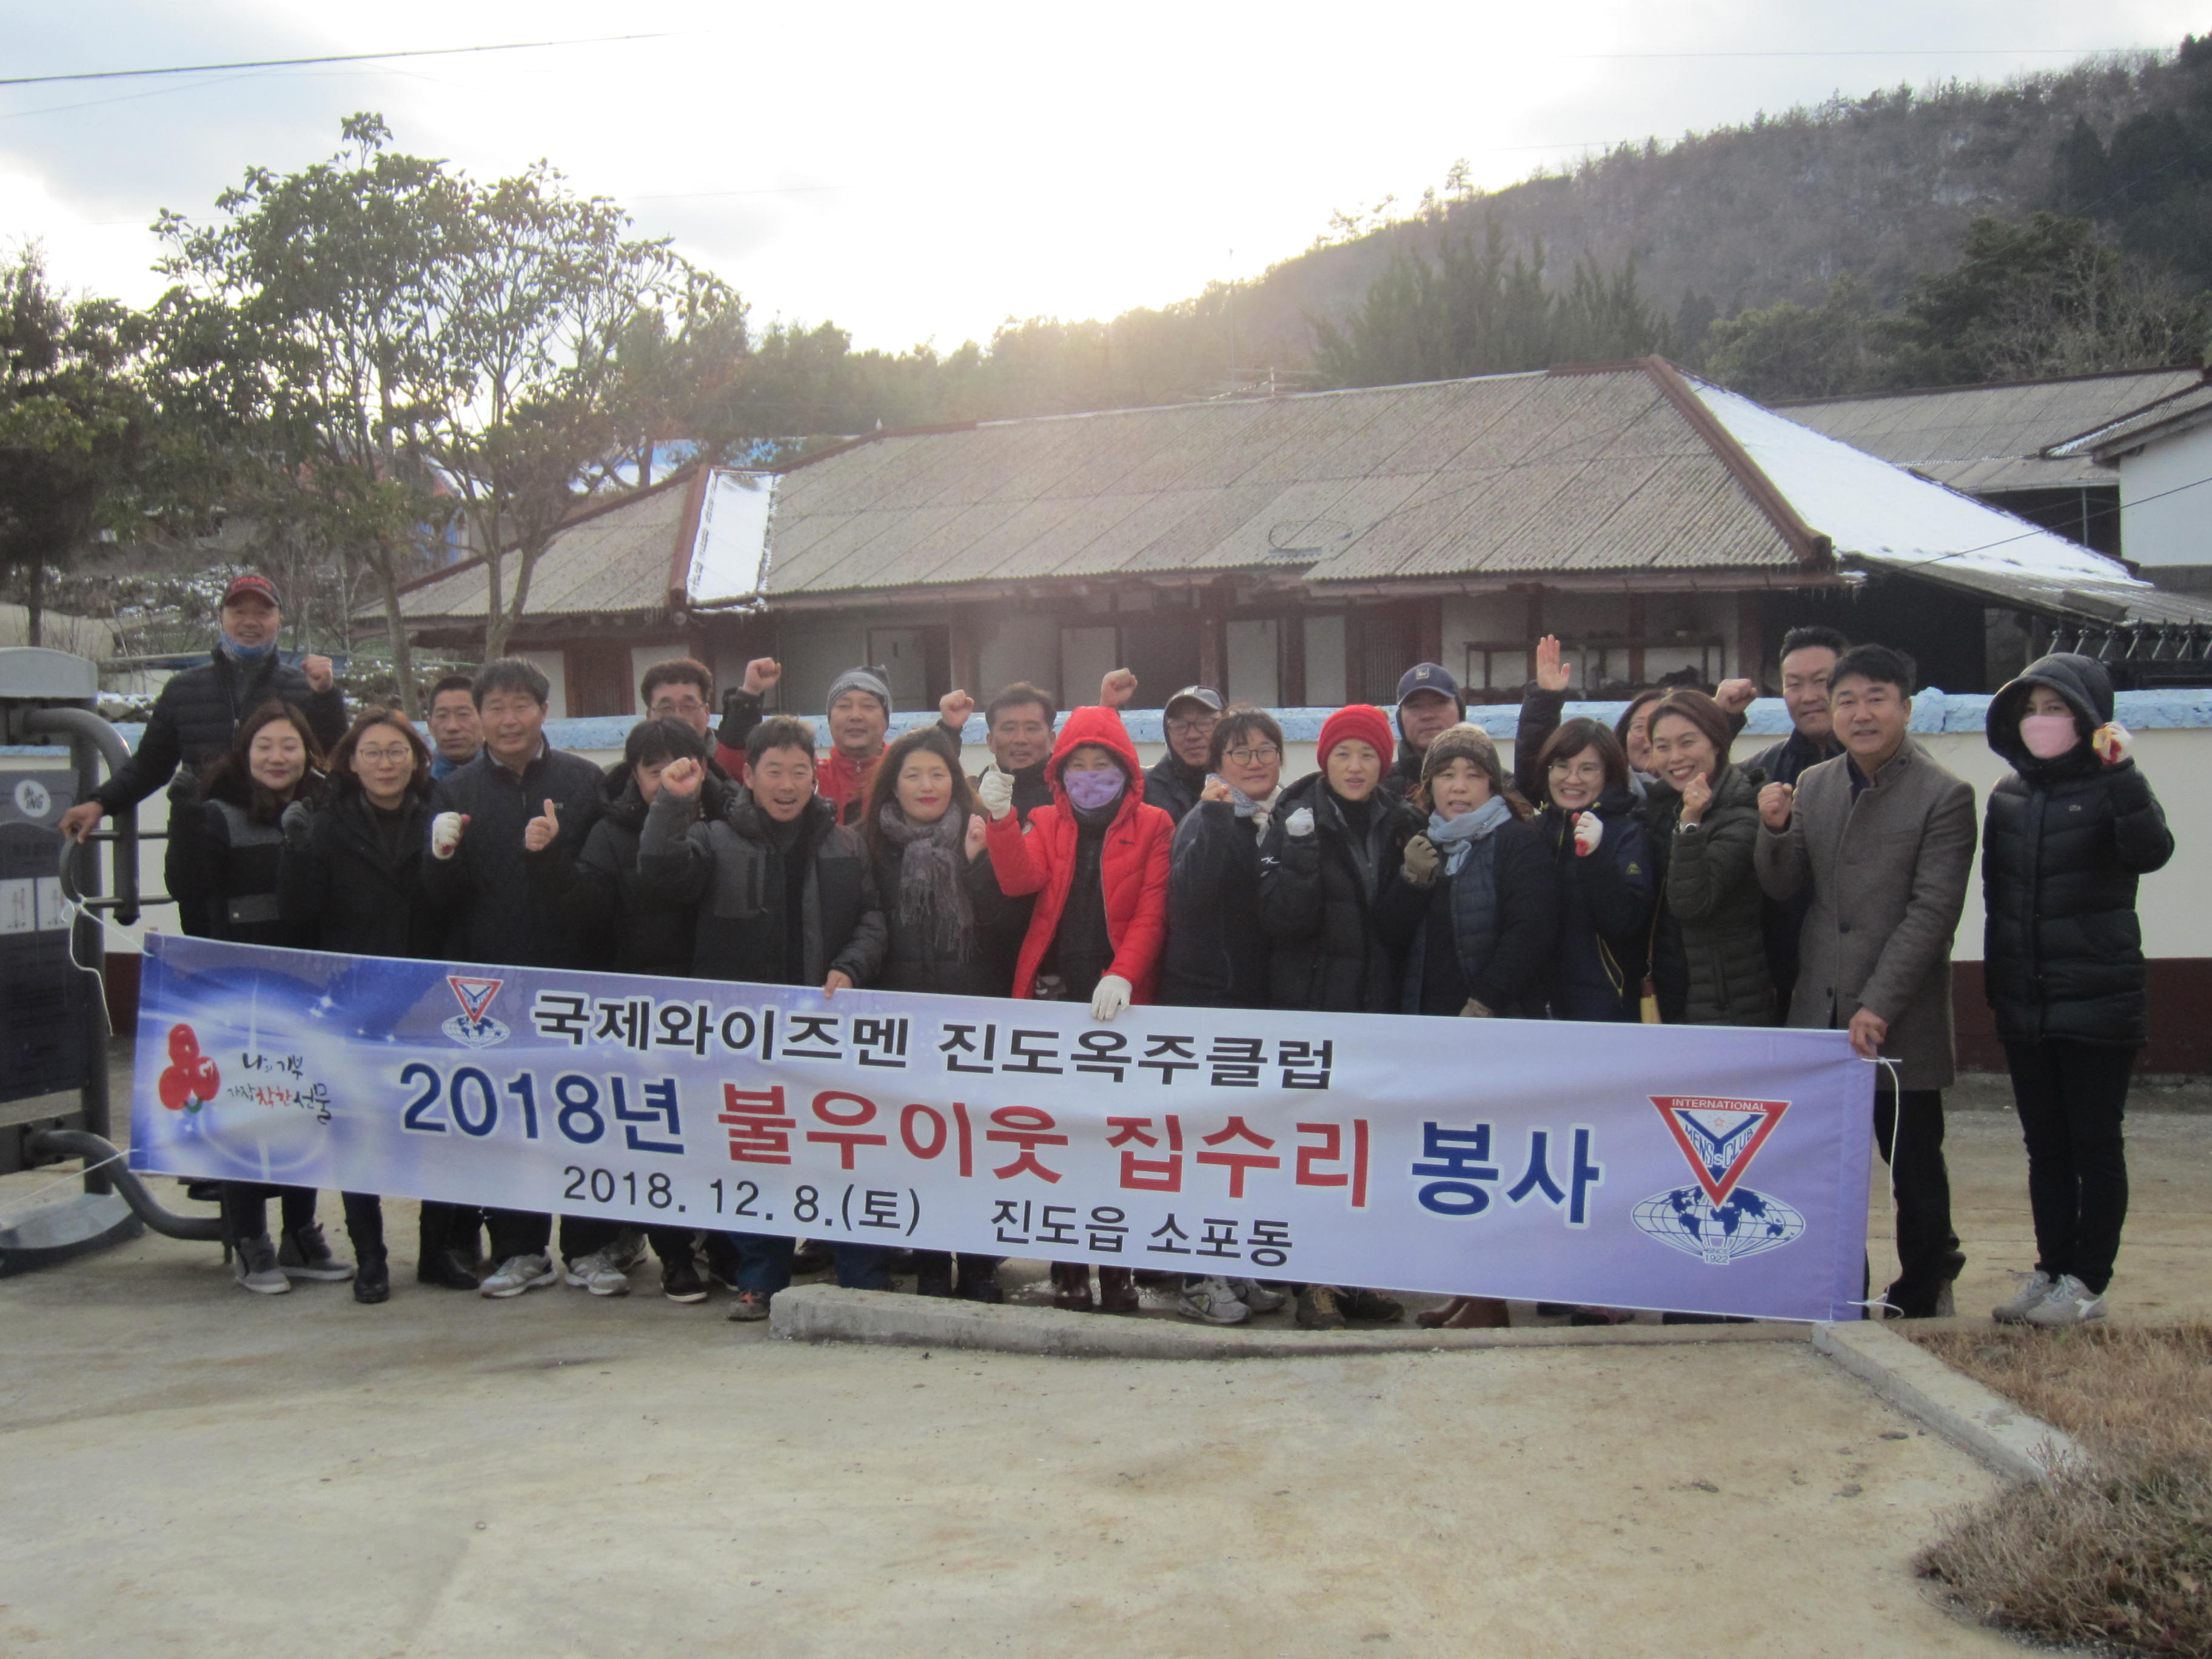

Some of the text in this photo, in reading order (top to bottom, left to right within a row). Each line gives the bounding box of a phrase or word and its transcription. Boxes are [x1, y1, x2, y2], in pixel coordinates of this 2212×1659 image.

[534, 995, 1333, 1090] 국제와이즈멘 진도옥주클럽
[276, 1055, 303, 1080] 기부
[255, 1084, 291, 1108] 착한
[293, 1083, 332, 1125] 선물
[1672, 1098, 1767, 1111] INTERNATIONAL
[400, 1062, 1600, 1224] 2018년 불우이웃 집수리 봉사
[1724, 1128, 1754, 1167] CLUB
[563, 1166, 920, 1236] 2018. 12. 8.(토)
[990, 1199, 1293, 1267] 진도읍 소포동
[1706, 1255, 1728, 1263] 1922
